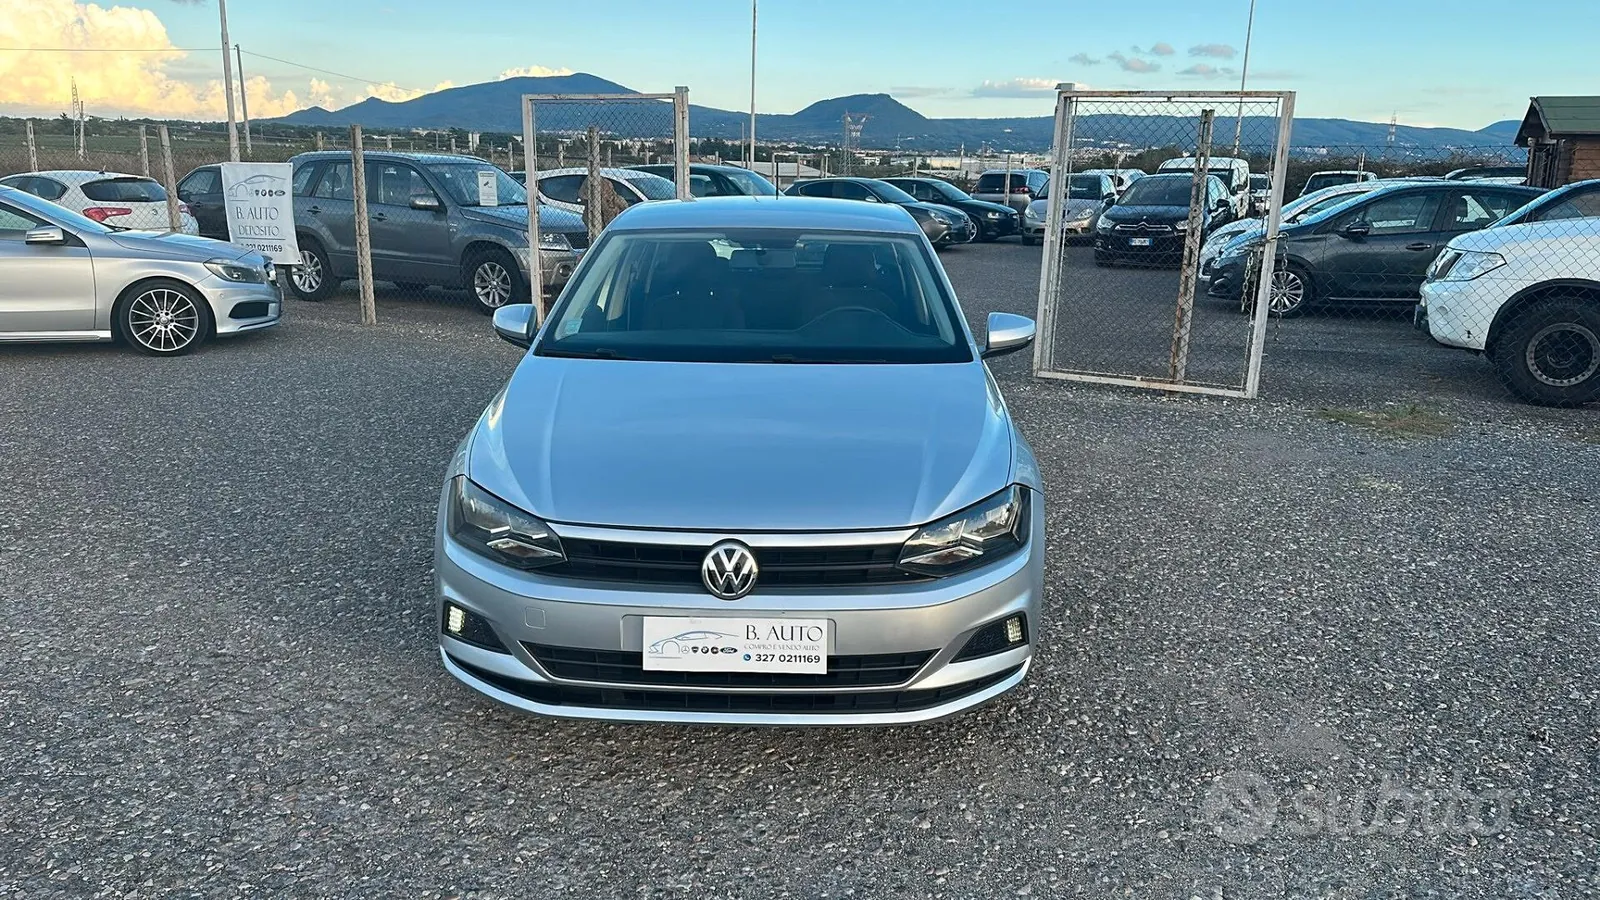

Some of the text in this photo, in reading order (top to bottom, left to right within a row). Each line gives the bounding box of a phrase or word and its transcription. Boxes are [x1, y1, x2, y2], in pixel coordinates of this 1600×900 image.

[236, 206, 279, 220] B. AUTO
[238, 225, 280, 236] DEPOSITO
[258, 244, 282, 252] 0211169
[746, 624, 823, 642] B. AUTO
[756, 654, 821, 663] 327 0211169
